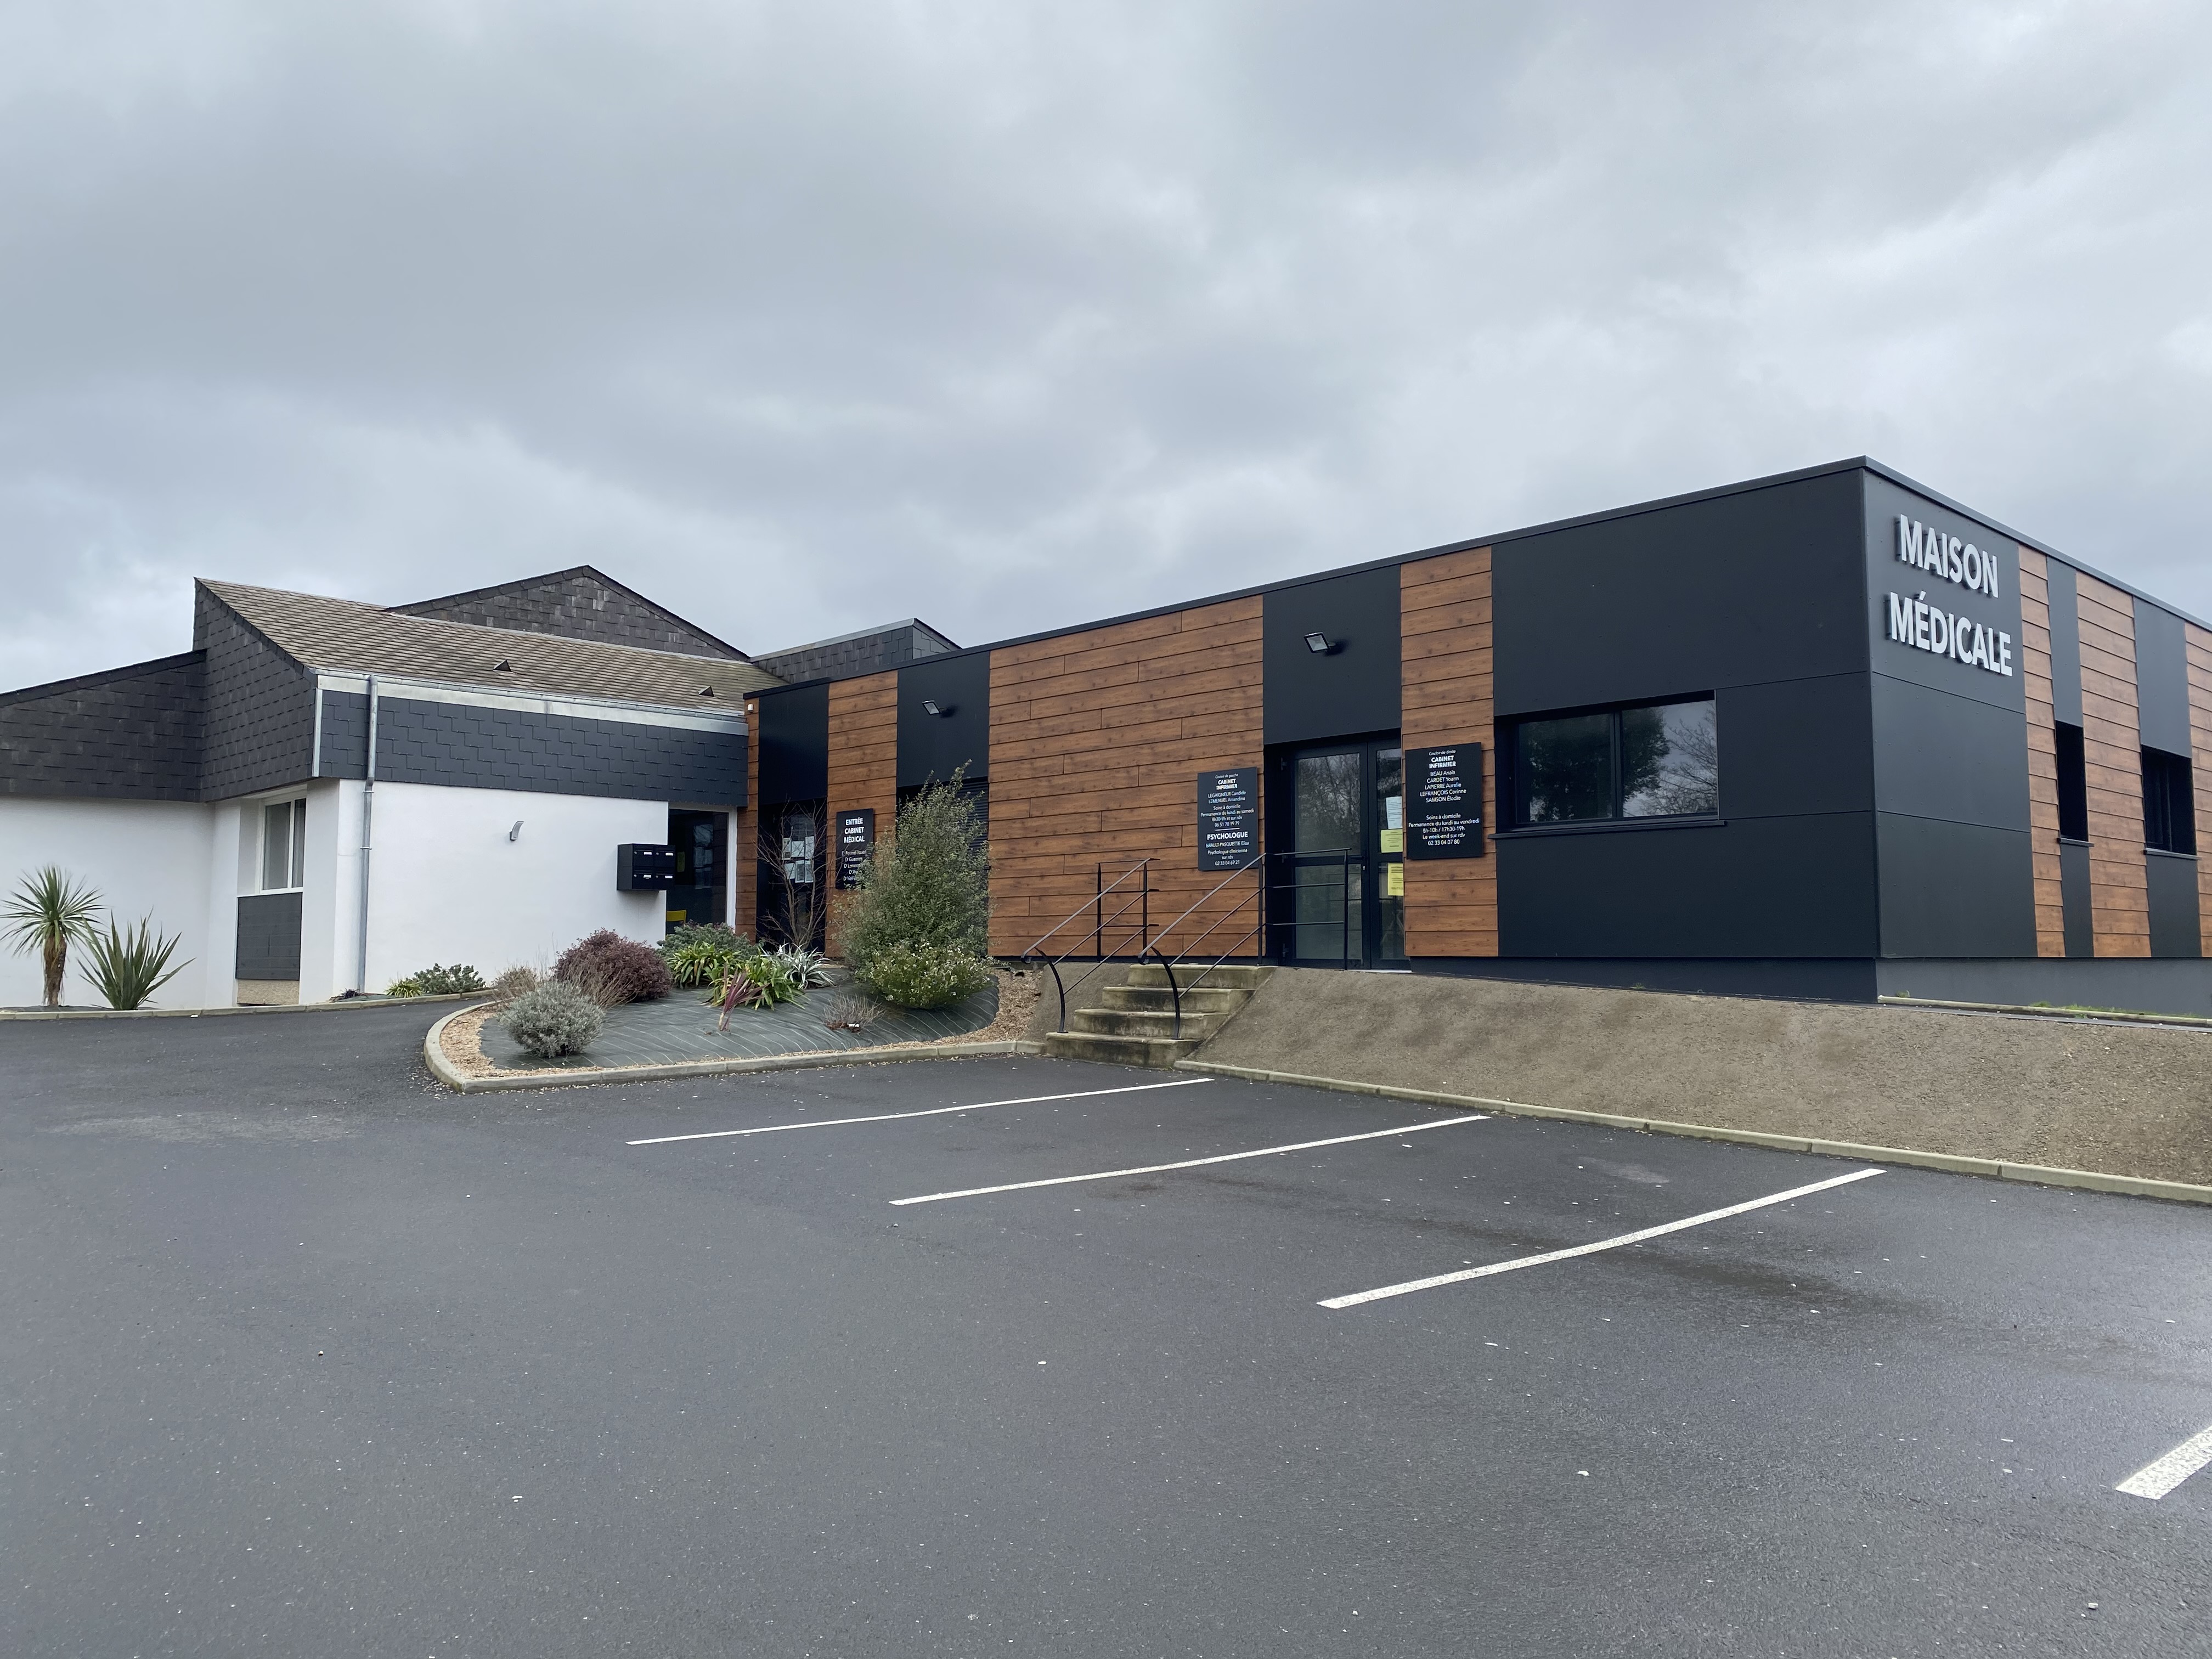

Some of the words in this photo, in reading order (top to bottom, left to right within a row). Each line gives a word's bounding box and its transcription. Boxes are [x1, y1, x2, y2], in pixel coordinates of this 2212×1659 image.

[1900, 514, 1999, 599] MAISON
[1890, 590, 2013, 677] MÉDICALE
[846, 817, 863, 825] ENTRÉE
[1207, 832, 1248, 840] PSYCHOLOGUE
